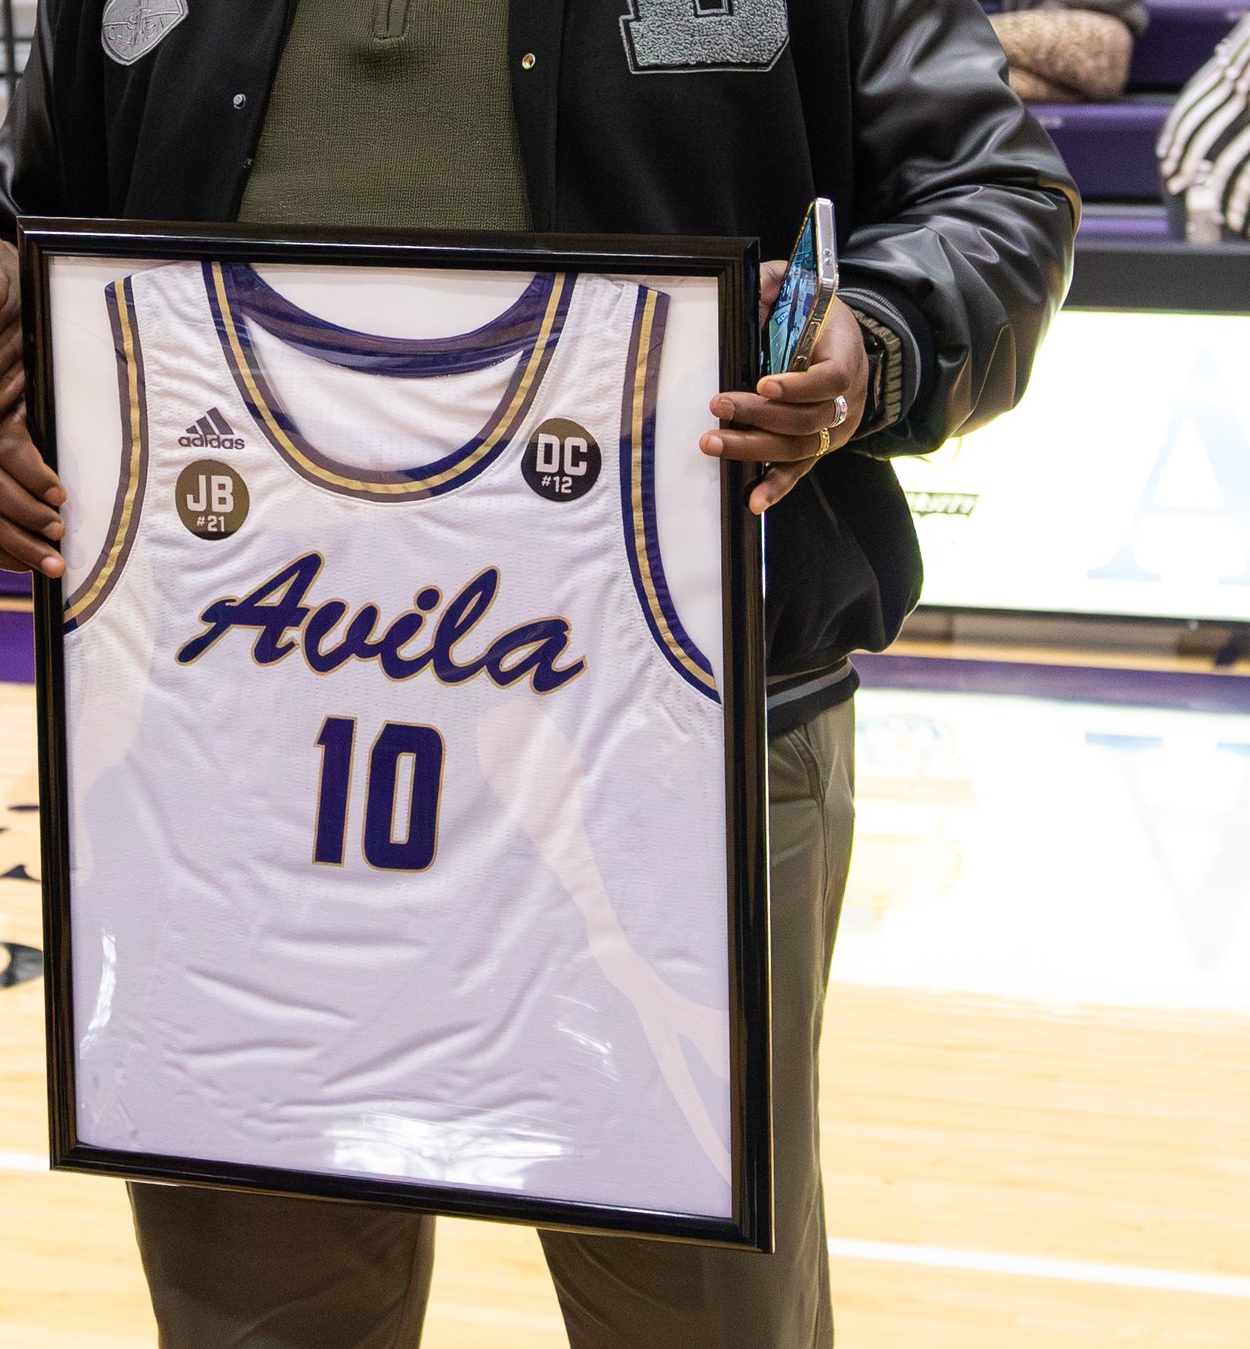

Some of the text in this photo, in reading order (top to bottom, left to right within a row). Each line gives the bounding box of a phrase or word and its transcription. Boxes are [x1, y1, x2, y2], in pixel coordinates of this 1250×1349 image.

[178, 433, 245, 450] adidas
[536, 433, 588, 476] DC
[186, 474, 234, 512] JB
[541, 475, 573, 493] #12
[196, 515, 226, 532] #21
[175, 550, 589, 695] Avila
[312, 714, 446, 874] 10
